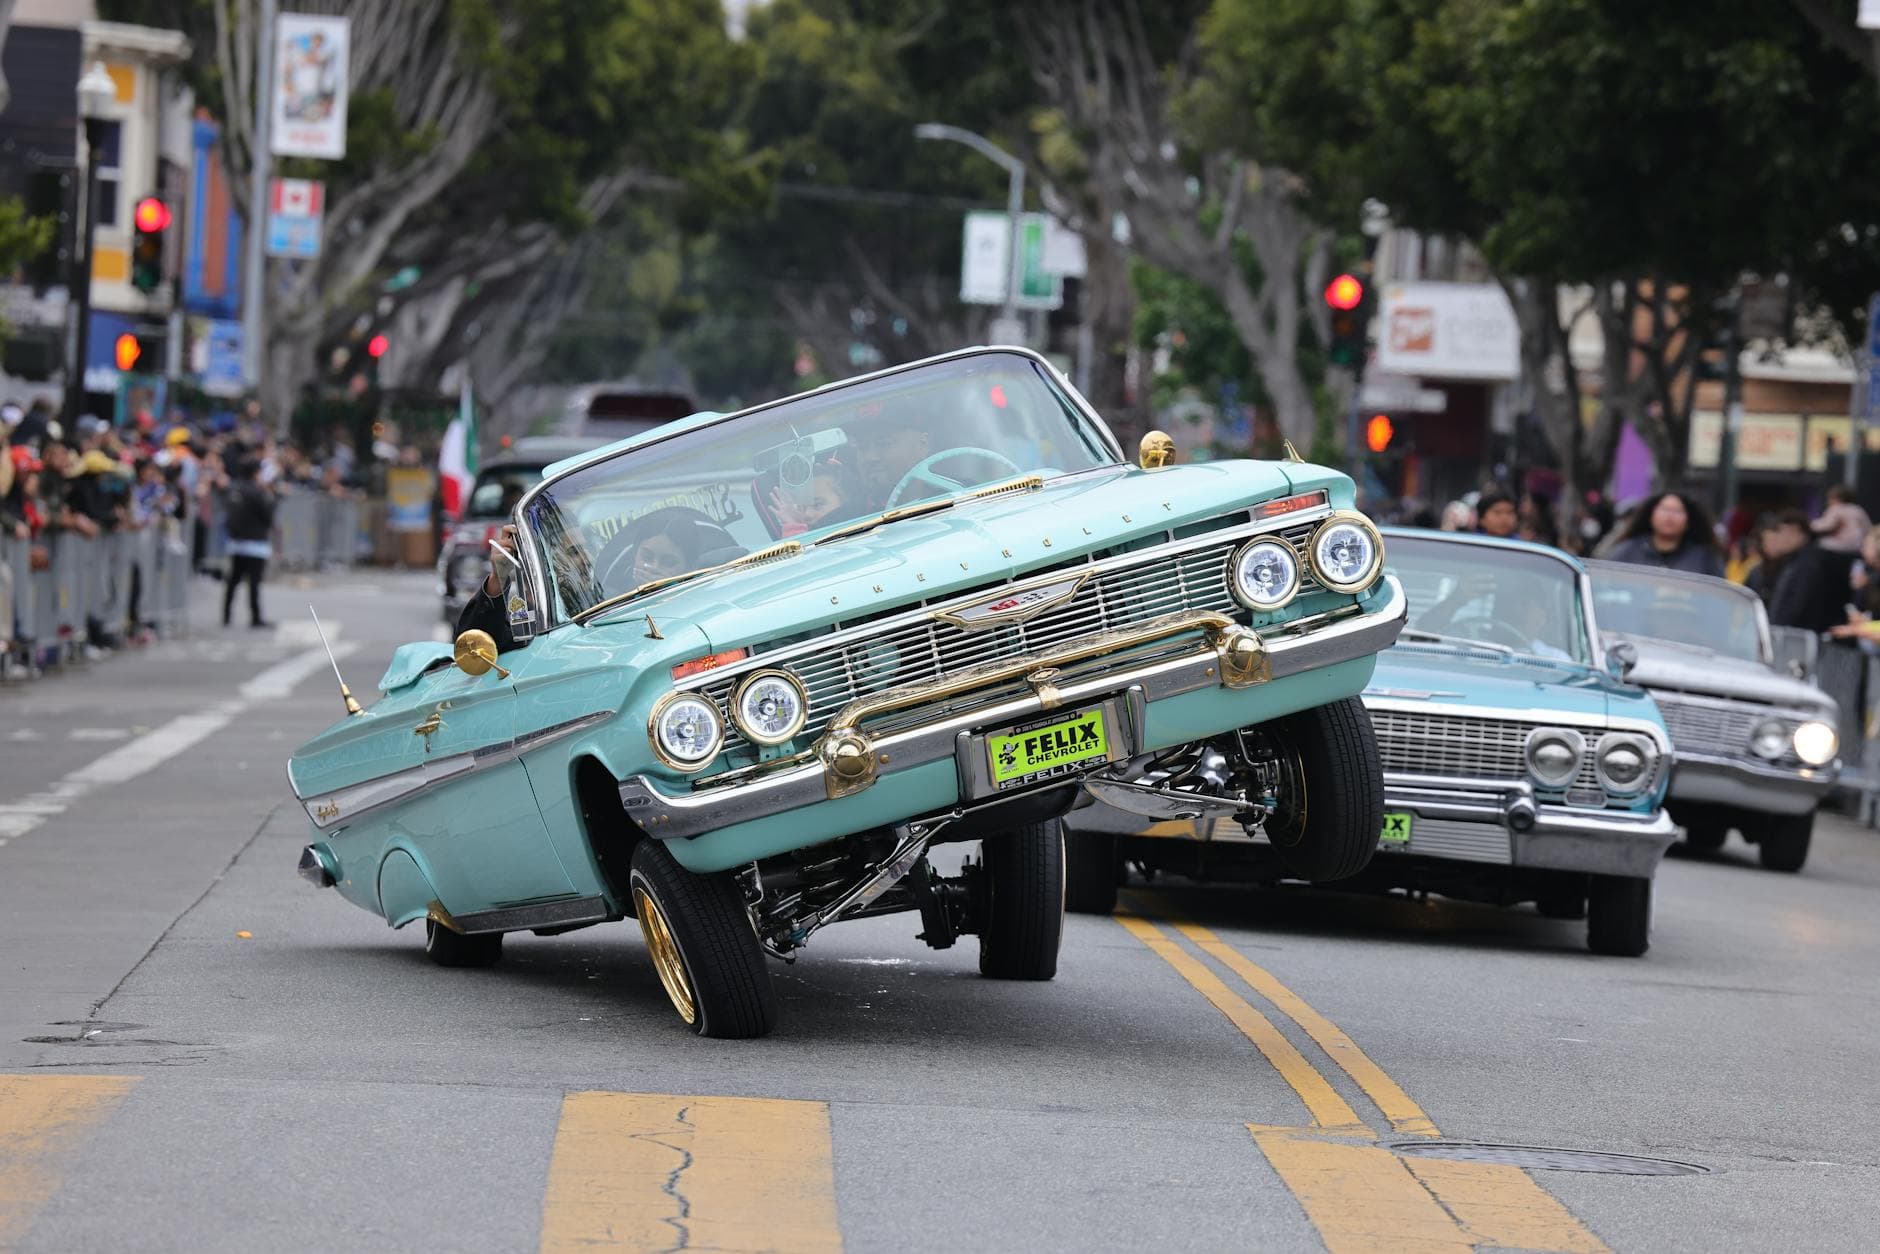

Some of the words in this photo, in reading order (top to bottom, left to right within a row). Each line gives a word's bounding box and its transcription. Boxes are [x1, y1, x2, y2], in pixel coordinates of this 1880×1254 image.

[830, 501, 1172, 605] CHEVROLET
[1024, 721, 1099, 757] FELIX
[1027, 739, 1100, 765] CHEVROLET
[1023, 761, 1083, 784] FELIX
